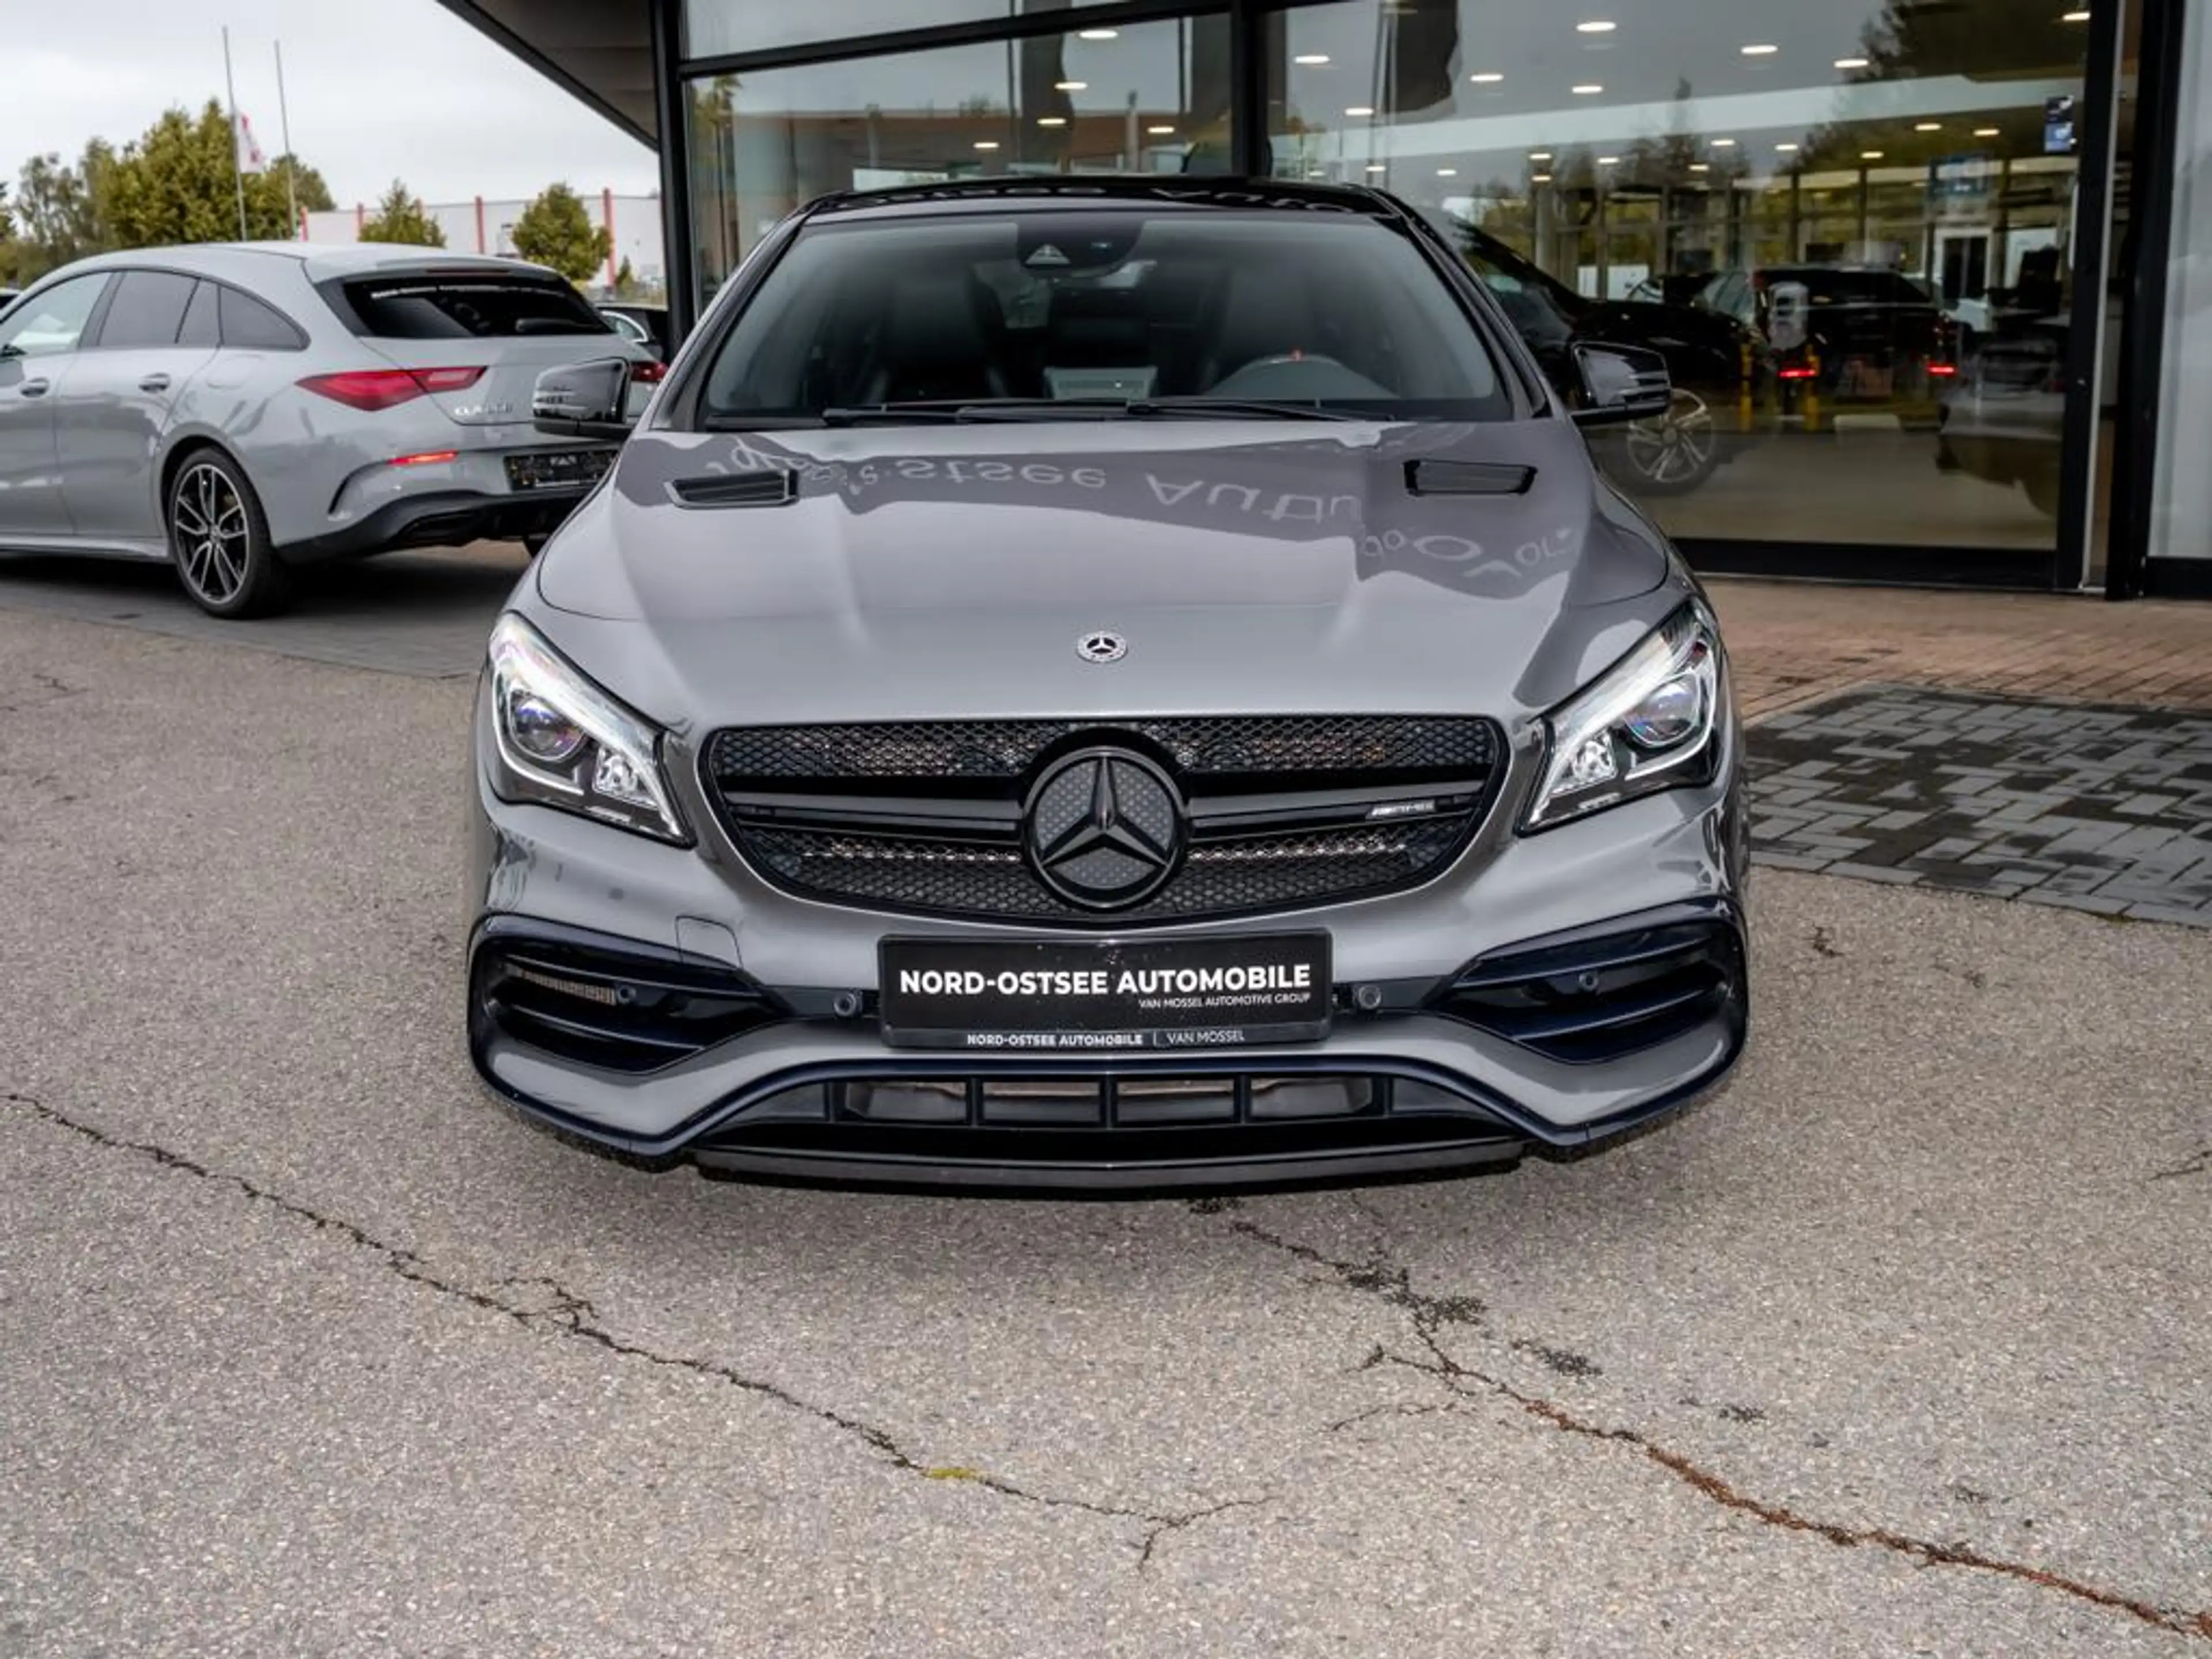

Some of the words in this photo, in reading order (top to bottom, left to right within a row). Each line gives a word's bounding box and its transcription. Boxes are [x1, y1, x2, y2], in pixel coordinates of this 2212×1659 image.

[899, 969, 1109, 995] NORD-OSTSEE
[1116, 963, 1310, 994] AUTOMOBILE
[1138, 998, 1161, 1009] VAN
[1164, 996, 1203, 1008] MOSSEL
[1205, 993, 1272, 1007] AUTOMOTIVE
[1274, 991, 1311, 1004] GROUP
[967, 1034, 1056, 1046] NORD-OSTSEE
[1058, 1034, 1143, 1046] AUTOMOBILE
[1166, 1032, 1194, 1044] VAN
[1197, 1030, 1245, 1043] MOSSEL
